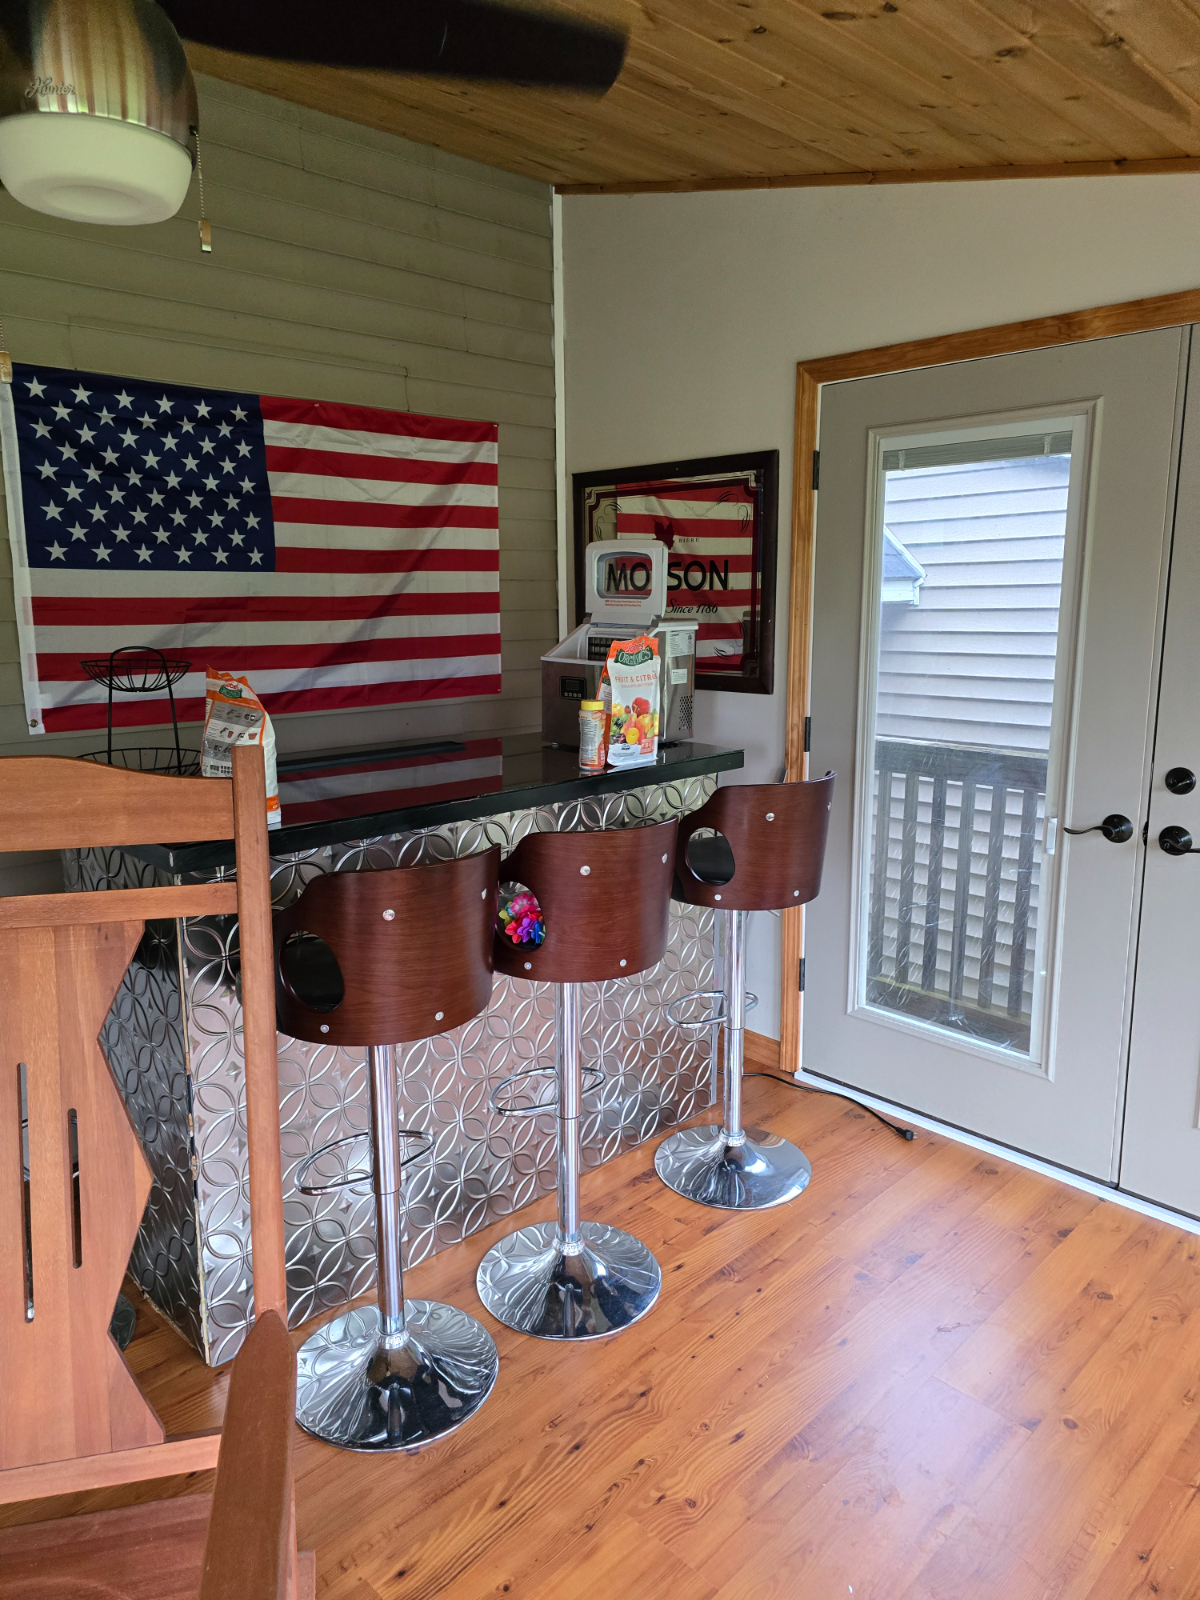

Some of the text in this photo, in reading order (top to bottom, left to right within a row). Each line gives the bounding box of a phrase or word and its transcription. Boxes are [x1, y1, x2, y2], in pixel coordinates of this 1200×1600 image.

[26, 77, 76, 97] Hunter
[607, 560, 729, 591] MOSON
[665, 597, 719, 614] Since 1786
[630, 675, 635, 683] &
